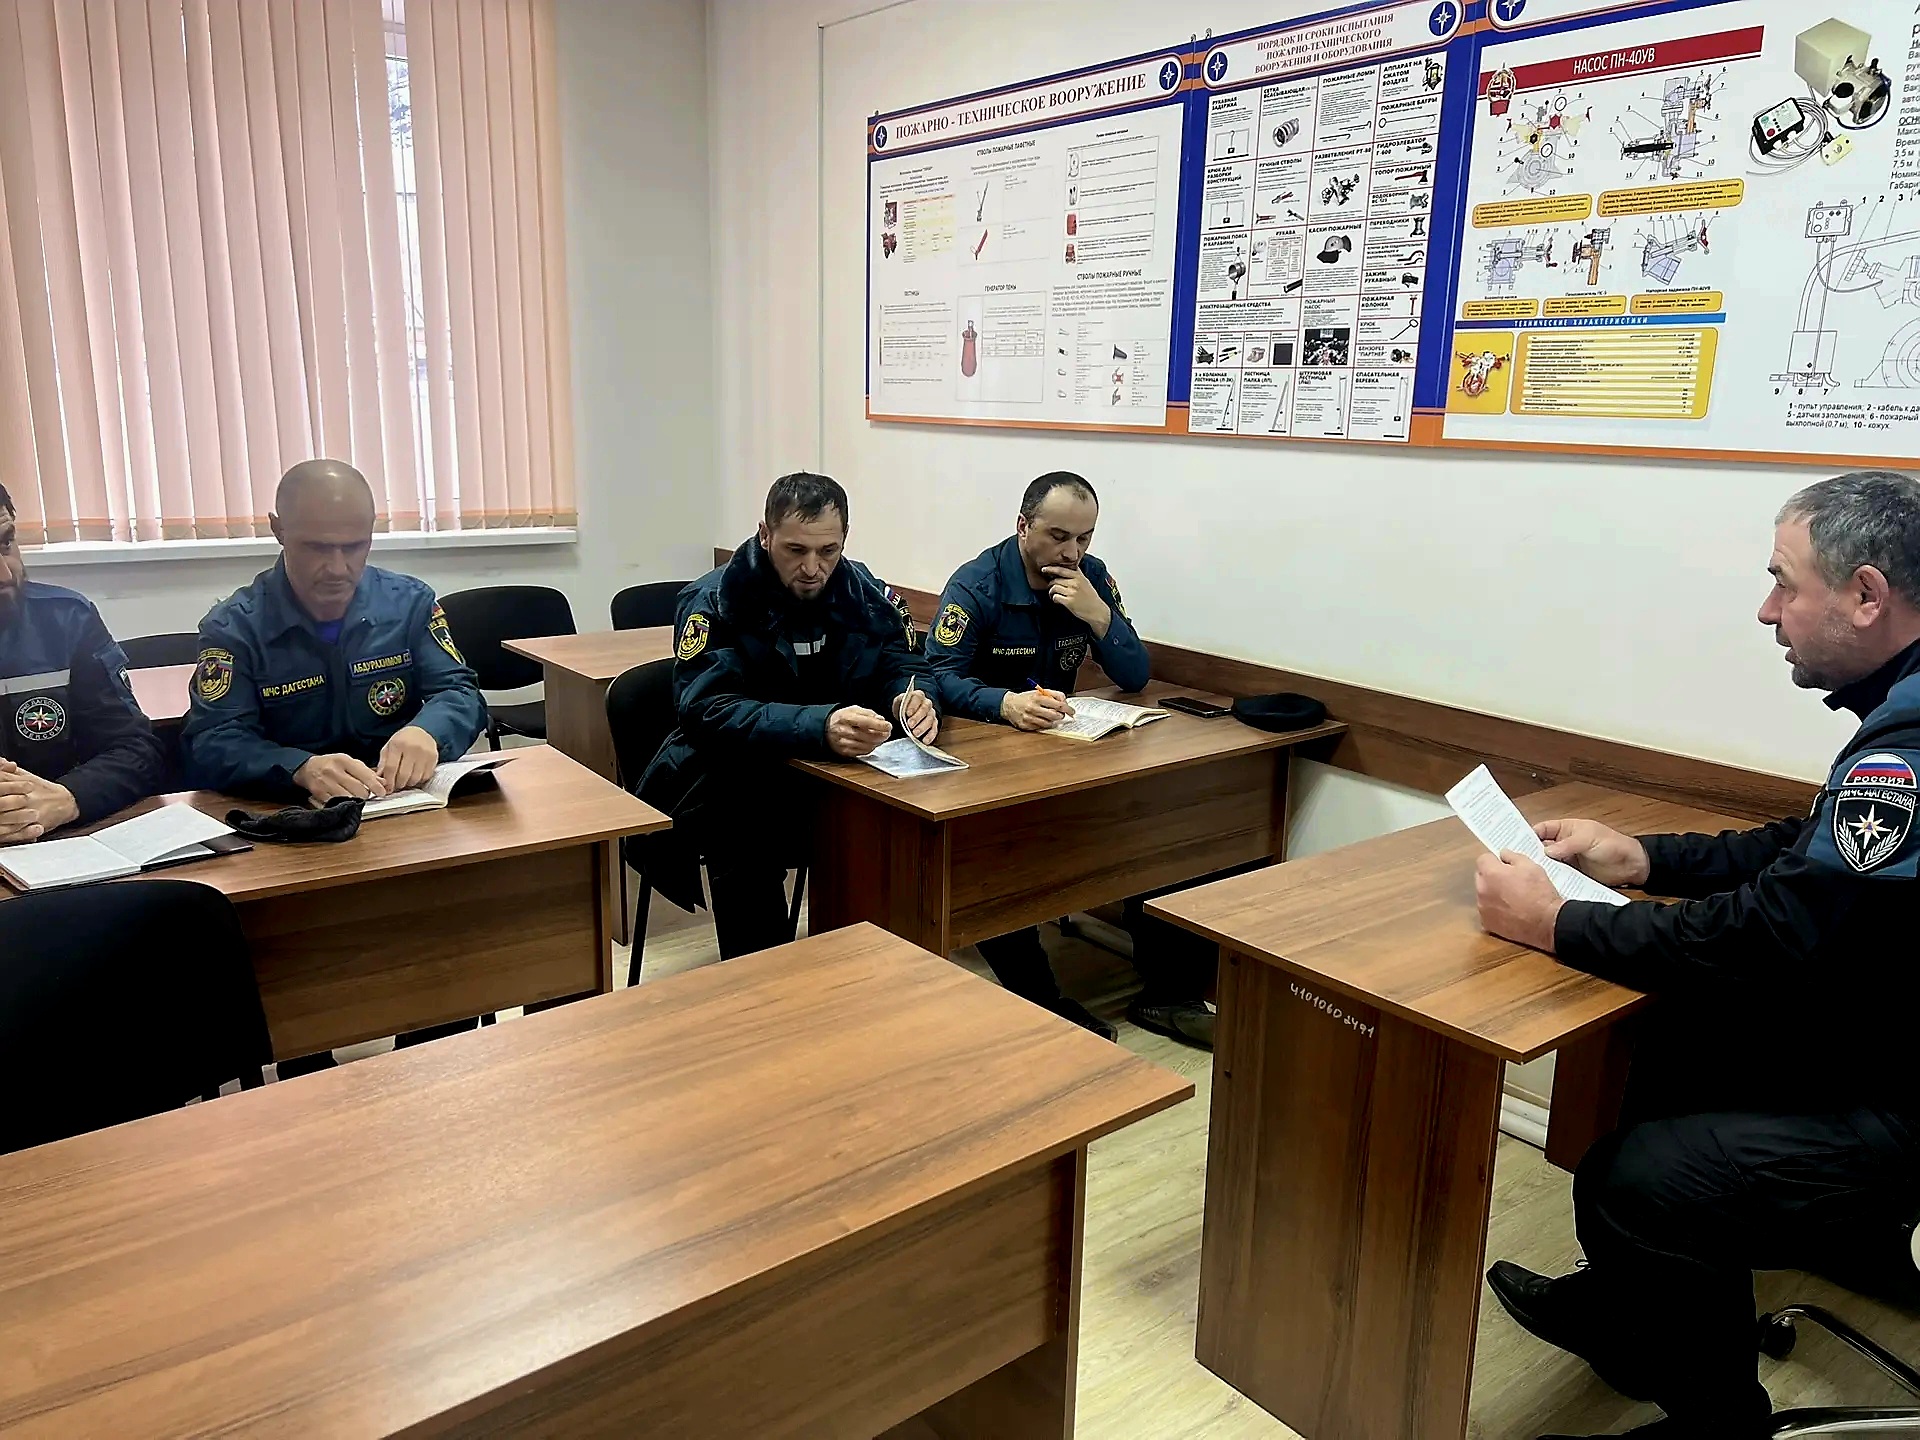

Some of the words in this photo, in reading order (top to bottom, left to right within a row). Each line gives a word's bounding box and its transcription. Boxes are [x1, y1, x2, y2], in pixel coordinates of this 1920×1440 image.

[1257, 35, 1296, 51] ПОРЯДОК
[1298, 34, 1303, 42] И
[1305, 27, 1334, 40] СРОКИ
[1336, 13, 1393, 34] ИСПЫТАНИЯ
[1266, 29, 1381, 60] ПОЖАРНО-ТЕХНИЧЕСКОГО
[1255, 55, 1311, 73] ВООРУЖЕНИЯ
[1321, 38, 1392, 60] ОБОРУДОВАНИЯ
[1574, 55, 1608, 75] НАСОС
[1610, 48, 1655, 68] ПН-40УВ
[1384, 62, 1412, 72] АППАРАТ
[1323, 73, 1355, 83] ПОЖАРНЫЕ
[1356, 70, 1375, 78] ЛОМЫ
[1383, 70, 1409, 79] СЖАТОМ
[1382, 77, 1408, 86] ВОЗДУХЕ
[1264, 88, 1305, 98] ВСАСЫВАЮЩАЯ
[1212, 96, 1237, 105] РУКАВНАЯ
[1381, 101, 1415, 111] ПОЖАРНЫЕ
[1416, 97, 1438, 106] БАГРЫ
[896, 116, 949, 139] ПОЖАРНО
[957, 95, 1046, 126] ТЕХНИЧЕСКОЕ
[1049, 73, 1147, 108] ВООРУЖЕНИЕ
[1212, 102, 1237, 110] ЗАДЕРЖКА
[1377, 137, 1426, 149] ГИДРОЭЛЕВАТОР
[1395, 164, 1432, 173] ПОЖАРНЫЙ
[1207, 175, 1241, 184] КОНСТРУКЦИЙ
[1862, 196, 1866, 204] 1
[1370, 218, 1409, 226] ПЕРЕХОДНИКИ
[1514, 319, 1568, 327] ТЕХНИЧЕСКИЕ
[1573, 317, 1648, 326] ХАРАКТЕРИСТИКИ
[353, 655, 402, 673] АБДУРАХИМОВ
[263, 686, 280, 697] МЧС
[282, 675, 324, 695] ДАГЕСТАНА
[1853, 776, 1905, 785] РОССИЯ
